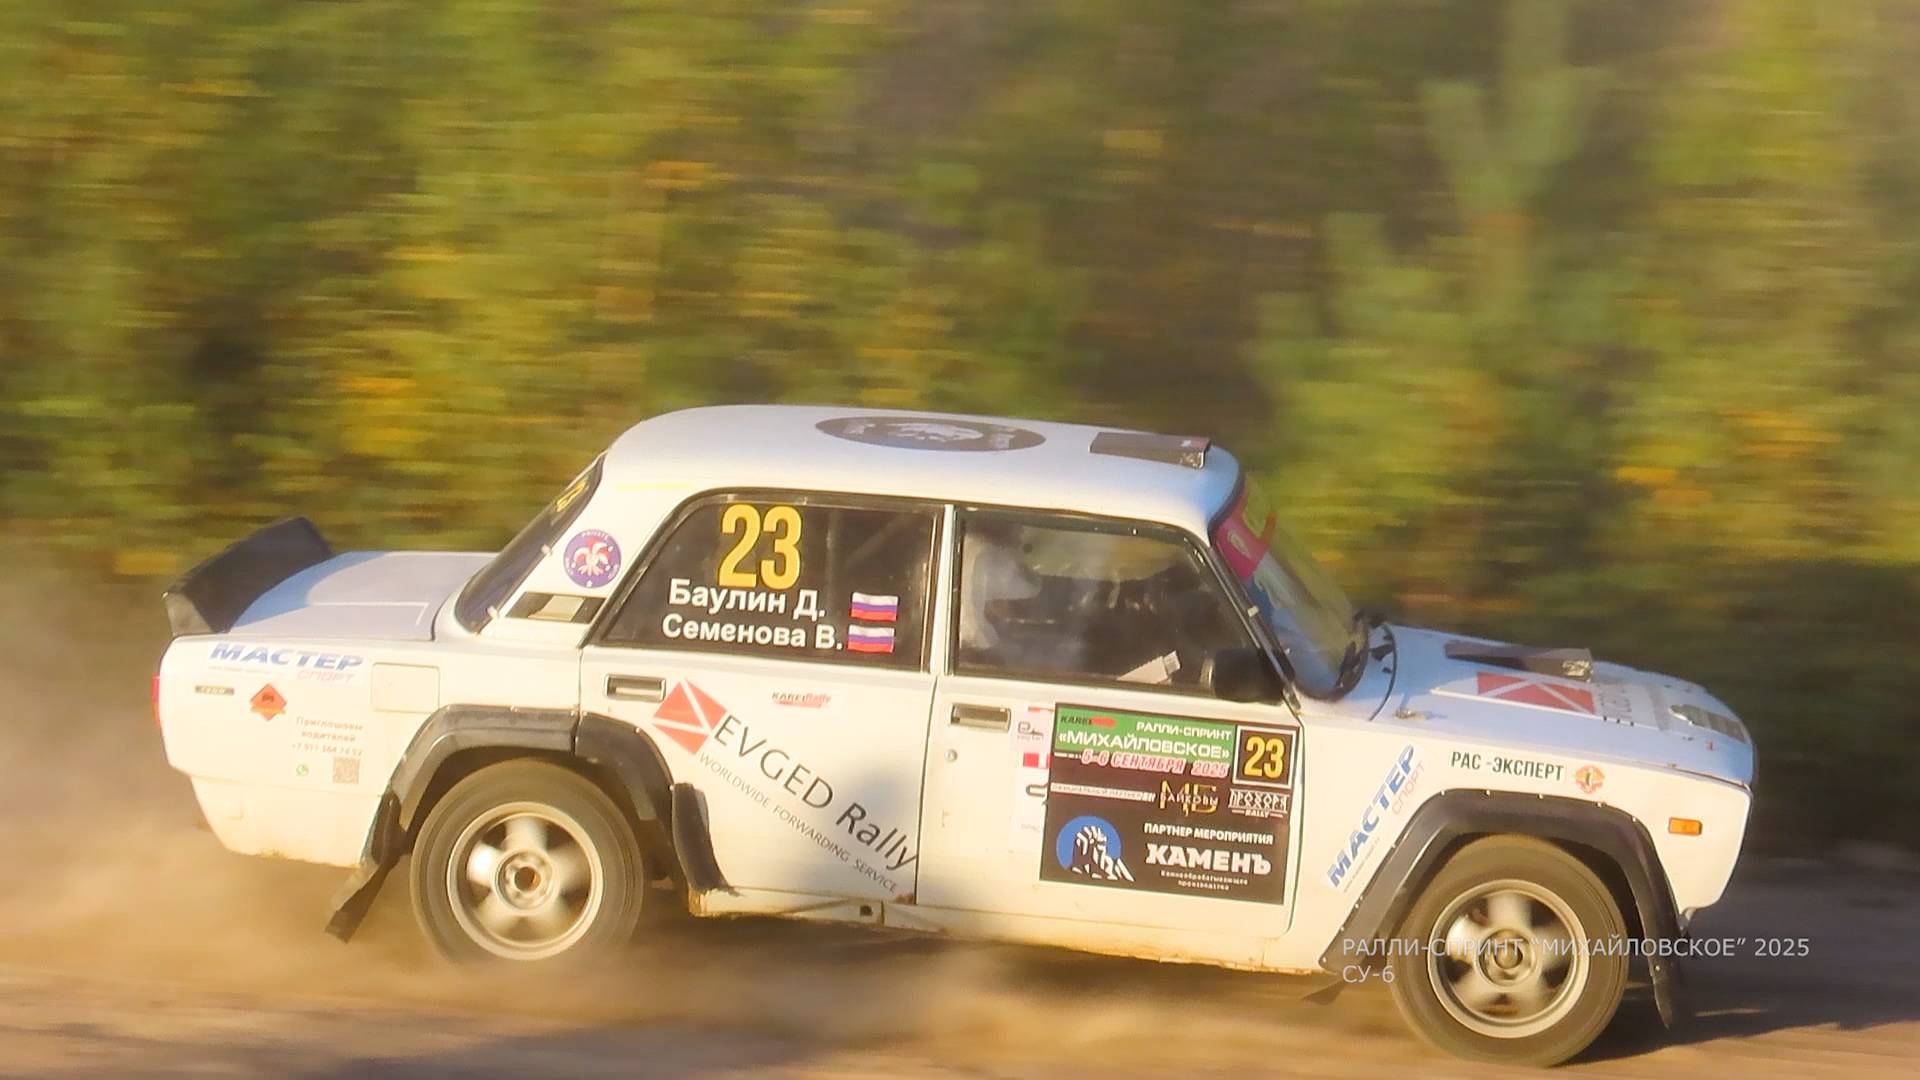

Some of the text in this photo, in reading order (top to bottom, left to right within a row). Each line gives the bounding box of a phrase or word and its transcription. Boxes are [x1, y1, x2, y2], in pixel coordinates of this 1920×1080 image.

[717, 504, 803, 590] 23
[668, 578, 826, 622] Баулин Д.
[662, 613, 843, 650] Семенова В.
[211, 643, 363, 670] МАСТЕР
[298, 670, 355, 682] СПОРТ
[1058, 729, 1230, 759] «МИХАЙЛОВСКОЕ»
[1136, 721, 1233, 740] РАЛЛИ-СПРИНТ
[1111, 751, 1187, 774] СЕНТЯБРЯ
[1190, 761, 1230, 779] 2025
[1244, 736, 1285, 778] 23
[1451, 751, 1481, 770] РАС
[714, 714, 920, 872] EVGED Rally
[1392, 760, 1425, 816] СПОРТ
[699, 752, 898, 894] WORLDWIDE FORWARDING SERVICE
[1143, 822, 1274, 845] ПАРТНЕР МЕРОПРИЯТИЯ
[1327, 744, 1415, 888] МАСТЕР
[1145, 843, 1272, 876] КАМЕНЪ
